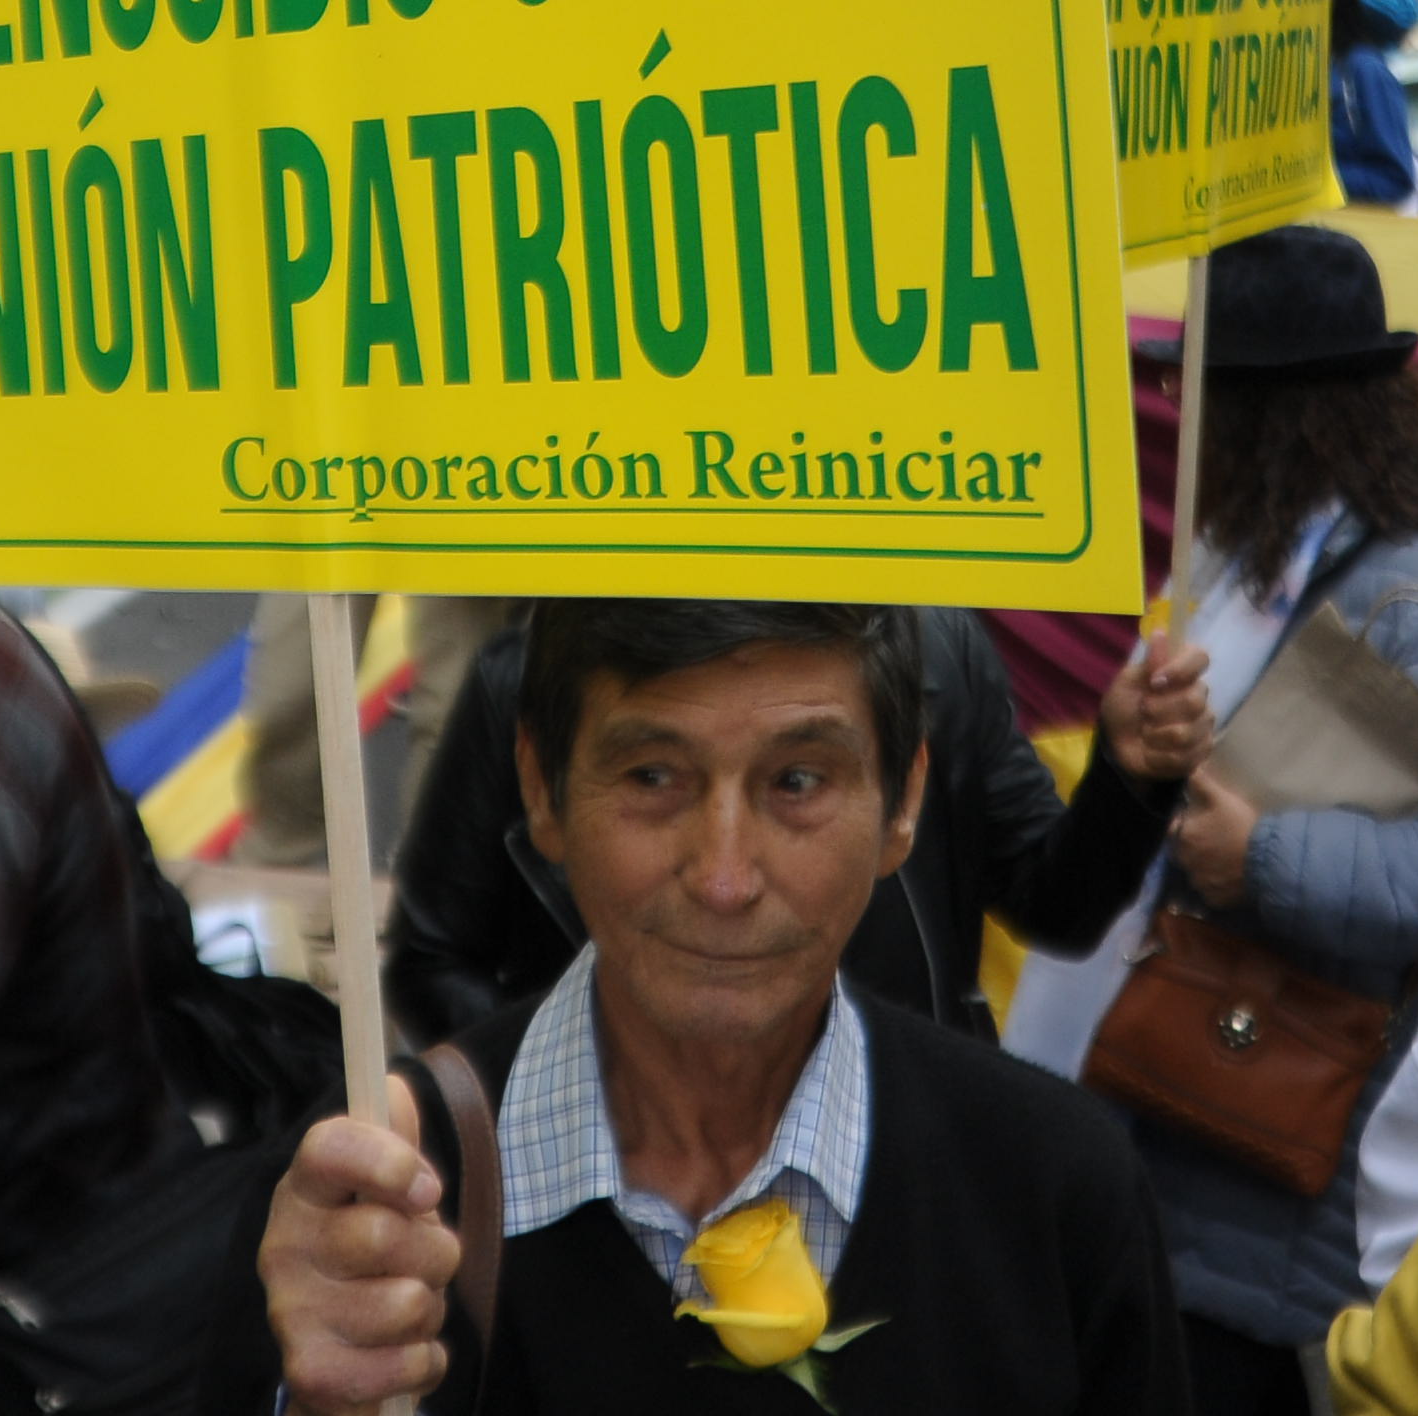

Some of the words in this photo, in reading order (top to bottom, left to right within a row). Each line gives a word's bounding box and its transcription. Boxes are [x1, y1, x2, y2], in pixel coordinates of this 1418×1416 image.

[1112, 20, 1190, 161] NIÓN
[258, 29, 1040, 389] PATRIÓTICA
[221, 431, 667, 522] Corporación
[684, 430, 1043, 502] Reiniciar
